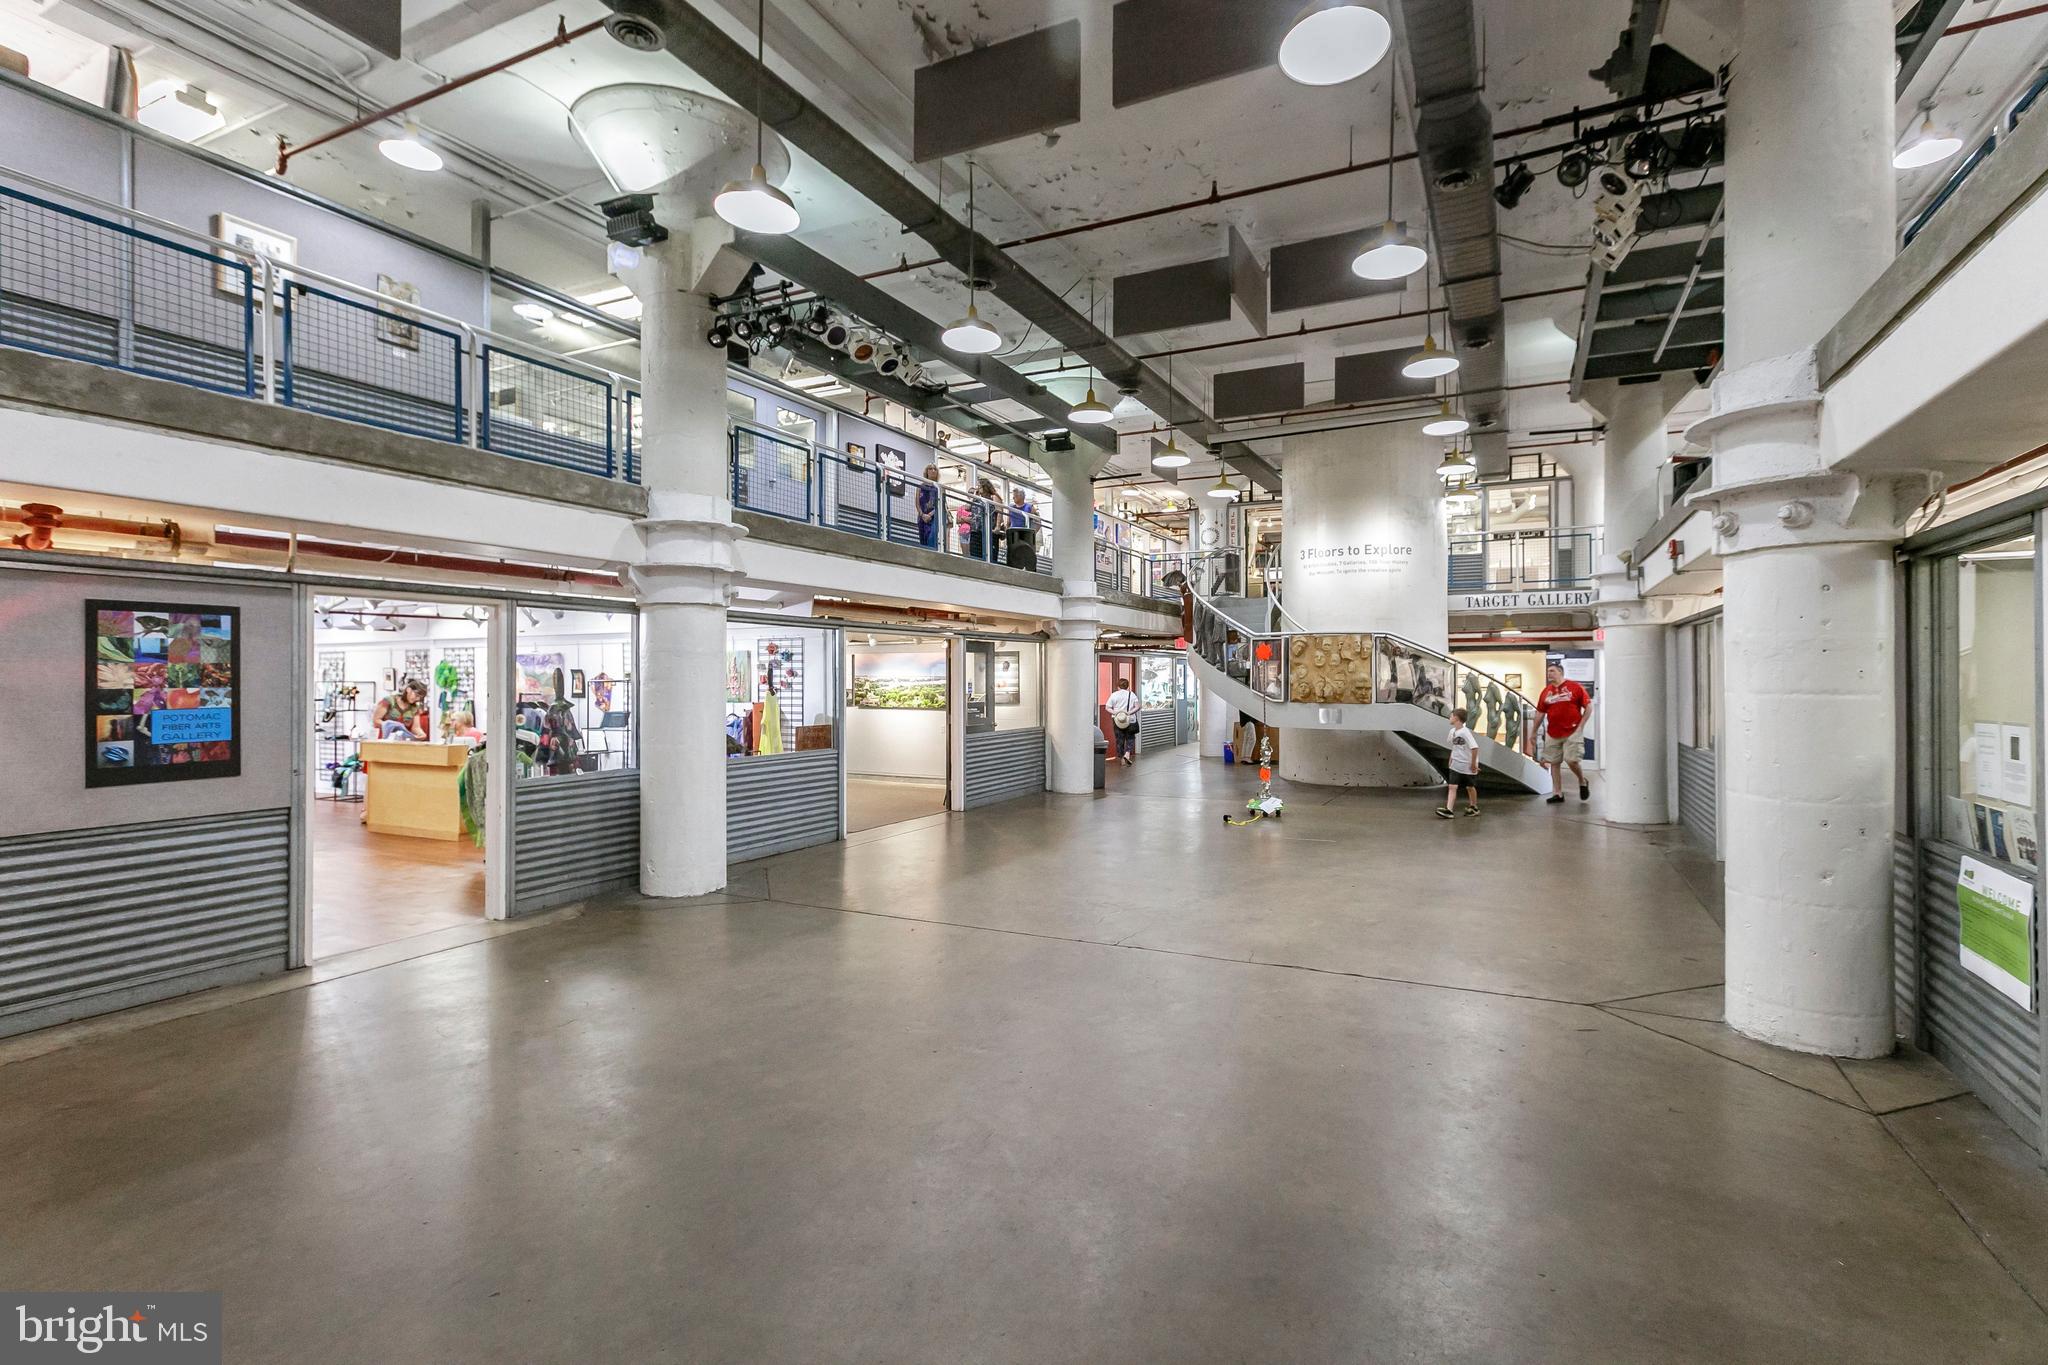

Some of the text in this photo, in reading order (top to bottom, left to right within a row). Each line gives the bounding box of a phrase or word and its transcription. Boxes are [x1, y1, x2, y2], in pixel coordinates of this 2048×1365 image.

[1300, 544, 1412, 560] 3 Floors to Explore
[1465, 592, 1592, 608] TARGET GALLERY
[162, 713, 221, 722] POTOMAC
[161, 731, 221, 741] GALLERY
[1982, 885, 2021, 912] WELCOME
